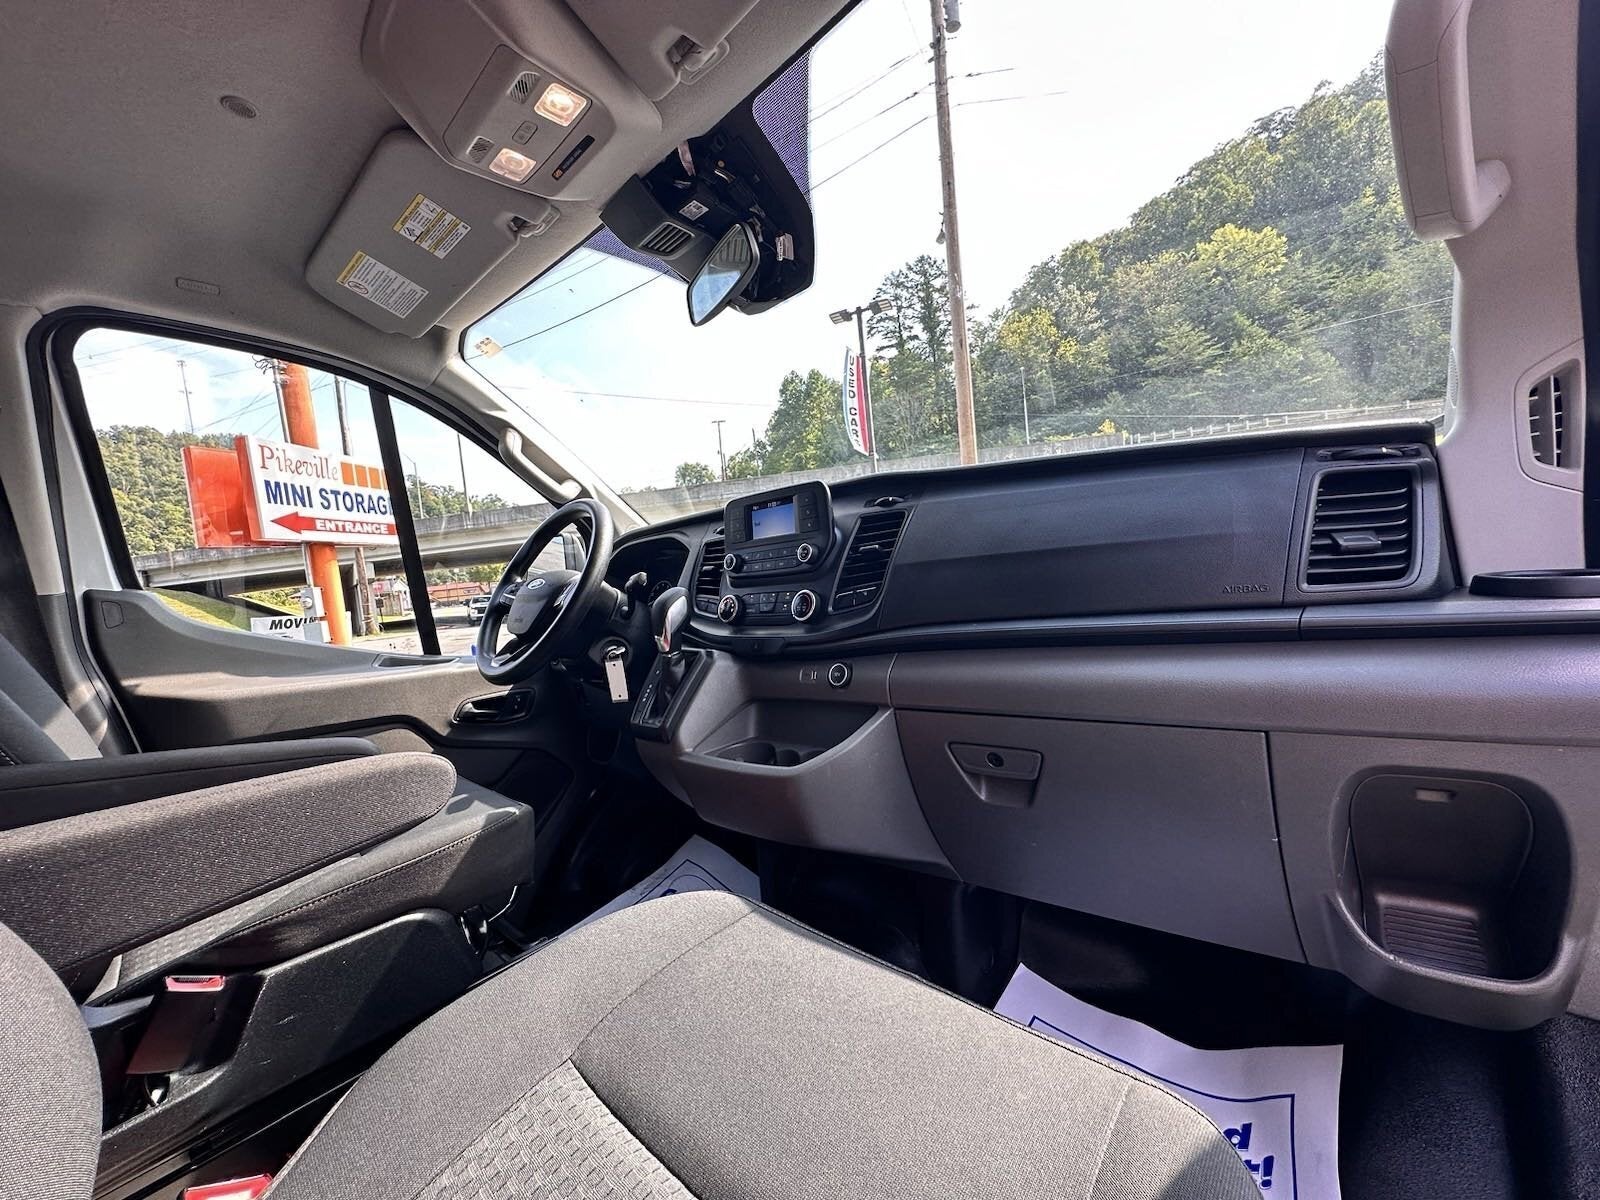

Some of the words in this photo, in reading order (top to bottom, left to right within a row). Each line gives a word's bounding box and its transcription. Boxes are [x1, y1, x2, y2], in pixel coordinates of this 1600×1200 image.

[849, 356, 857, 399] USED
[258, 444, 338, 481] Pikeville
[264, 479, 313, 508] MINI
[315, 519, 389, 534] ENTRANCE
[1222, 584, 1270, 594] AIRBAG
